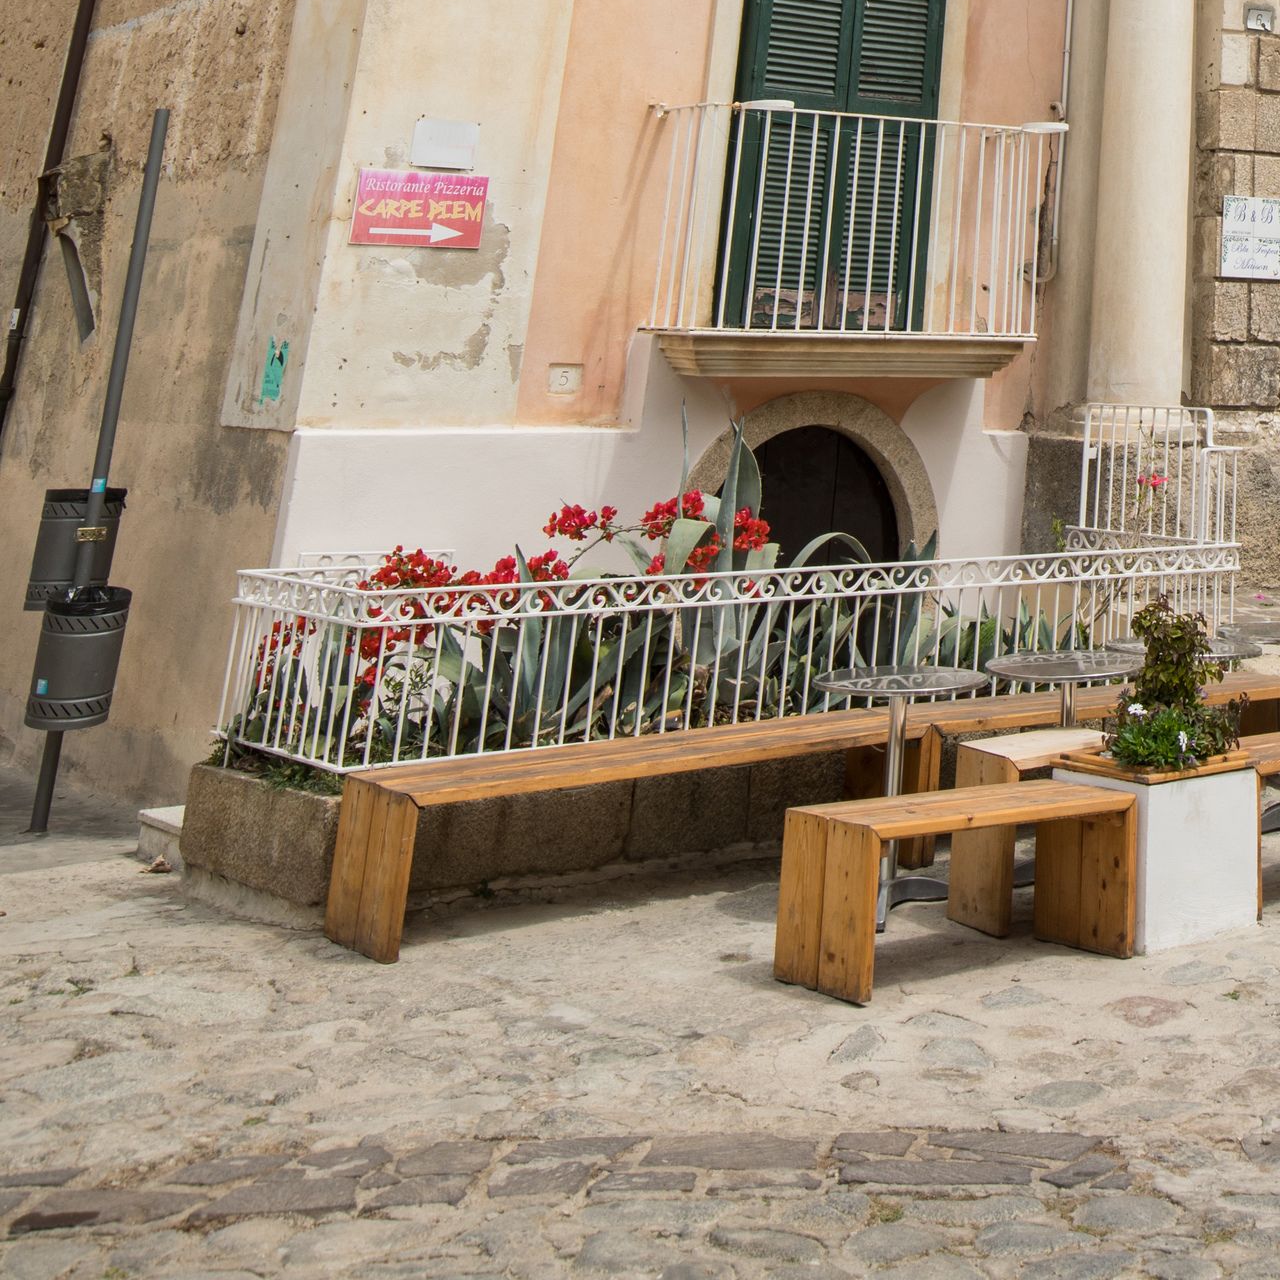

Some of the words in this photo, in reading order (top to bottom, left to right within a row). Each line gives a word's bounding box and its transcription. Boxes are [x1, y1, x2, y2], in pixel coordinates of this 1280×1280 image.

[366, 177, 431, 194] Ristorante
[434, 181, 485, 196] Pizzeria
[358, 198, 424, 219] CARPE
[427, 198, 483, 222] DIEM
[1234, 202, 1248, 223] B
[1250, 209, 1257, 223] &
[1261, 204, 1275, 224] B
[559, 370, 569, 387] 5
